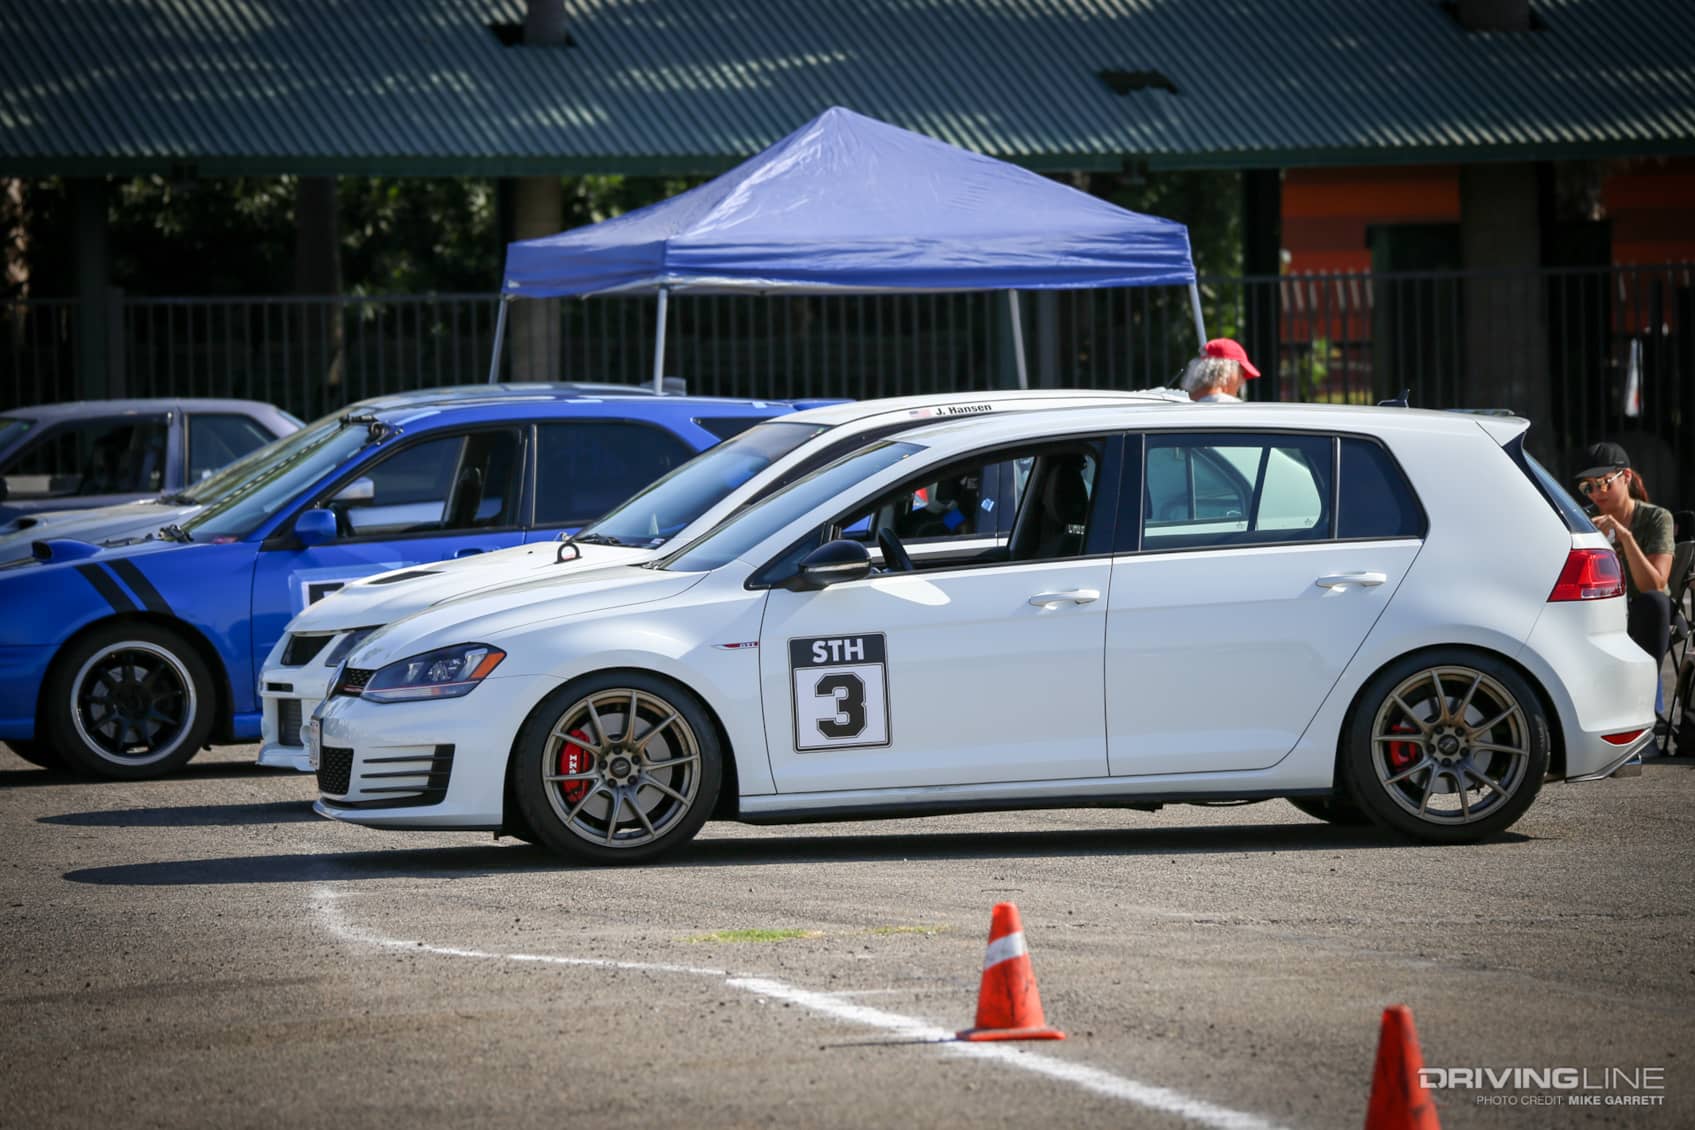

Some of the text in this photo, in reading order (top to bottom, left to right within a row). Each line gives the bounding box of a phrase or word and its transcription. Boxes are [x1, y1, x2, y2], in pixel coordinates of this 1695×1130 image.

[936, 404, 992, 416] J. Hansen
[812, 638, 865, 663] STH
[814, 672, 868, 740] 3
